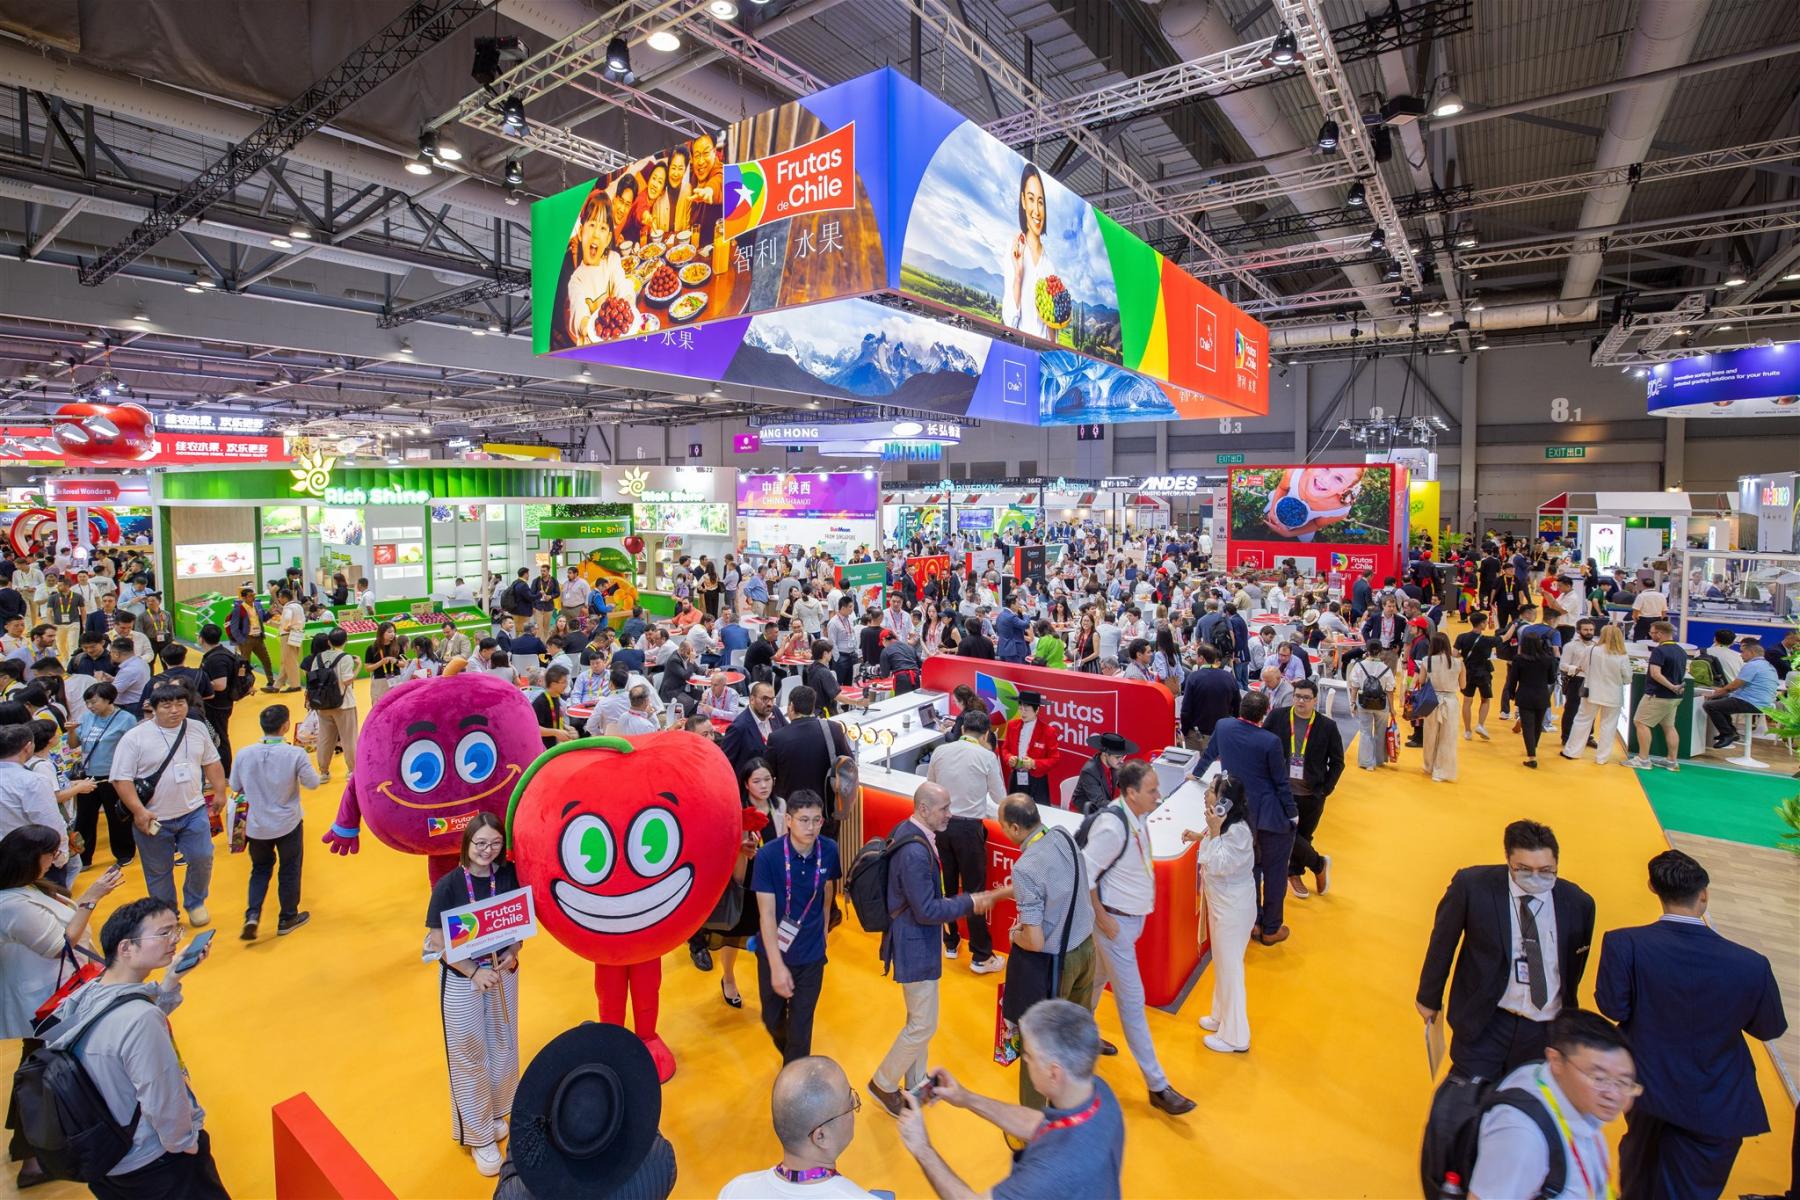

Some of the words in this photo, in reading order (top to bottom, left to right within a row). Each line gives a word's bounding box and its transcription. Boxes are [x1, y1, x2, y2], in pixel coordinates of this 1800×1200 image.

[777, 147, 843, 184] Frutas
[777, 200, 789, 212] de
[788, 175, 843, 208] Chile
[734, 237, 777, 275] 智利
[794, 221, 844, 259] 水果
[661, 330, 695, 350] 水果
[1746, 371, 1761, 379] your
[1551, 397, 1582, 423] 8.1
[783, 428, 819, 438] HONG
[1548, 447, 1566, 457] EXIT
[1566, 447, 1583, 457] 出口
[1137, 475, 1198, 491] ANDES
[324, 487, 367, 505] Rich
[368, 486, 431, 505] Shine
[484, 902, 522, 921] Frutas
[492, 911, 524, 930] Chile
